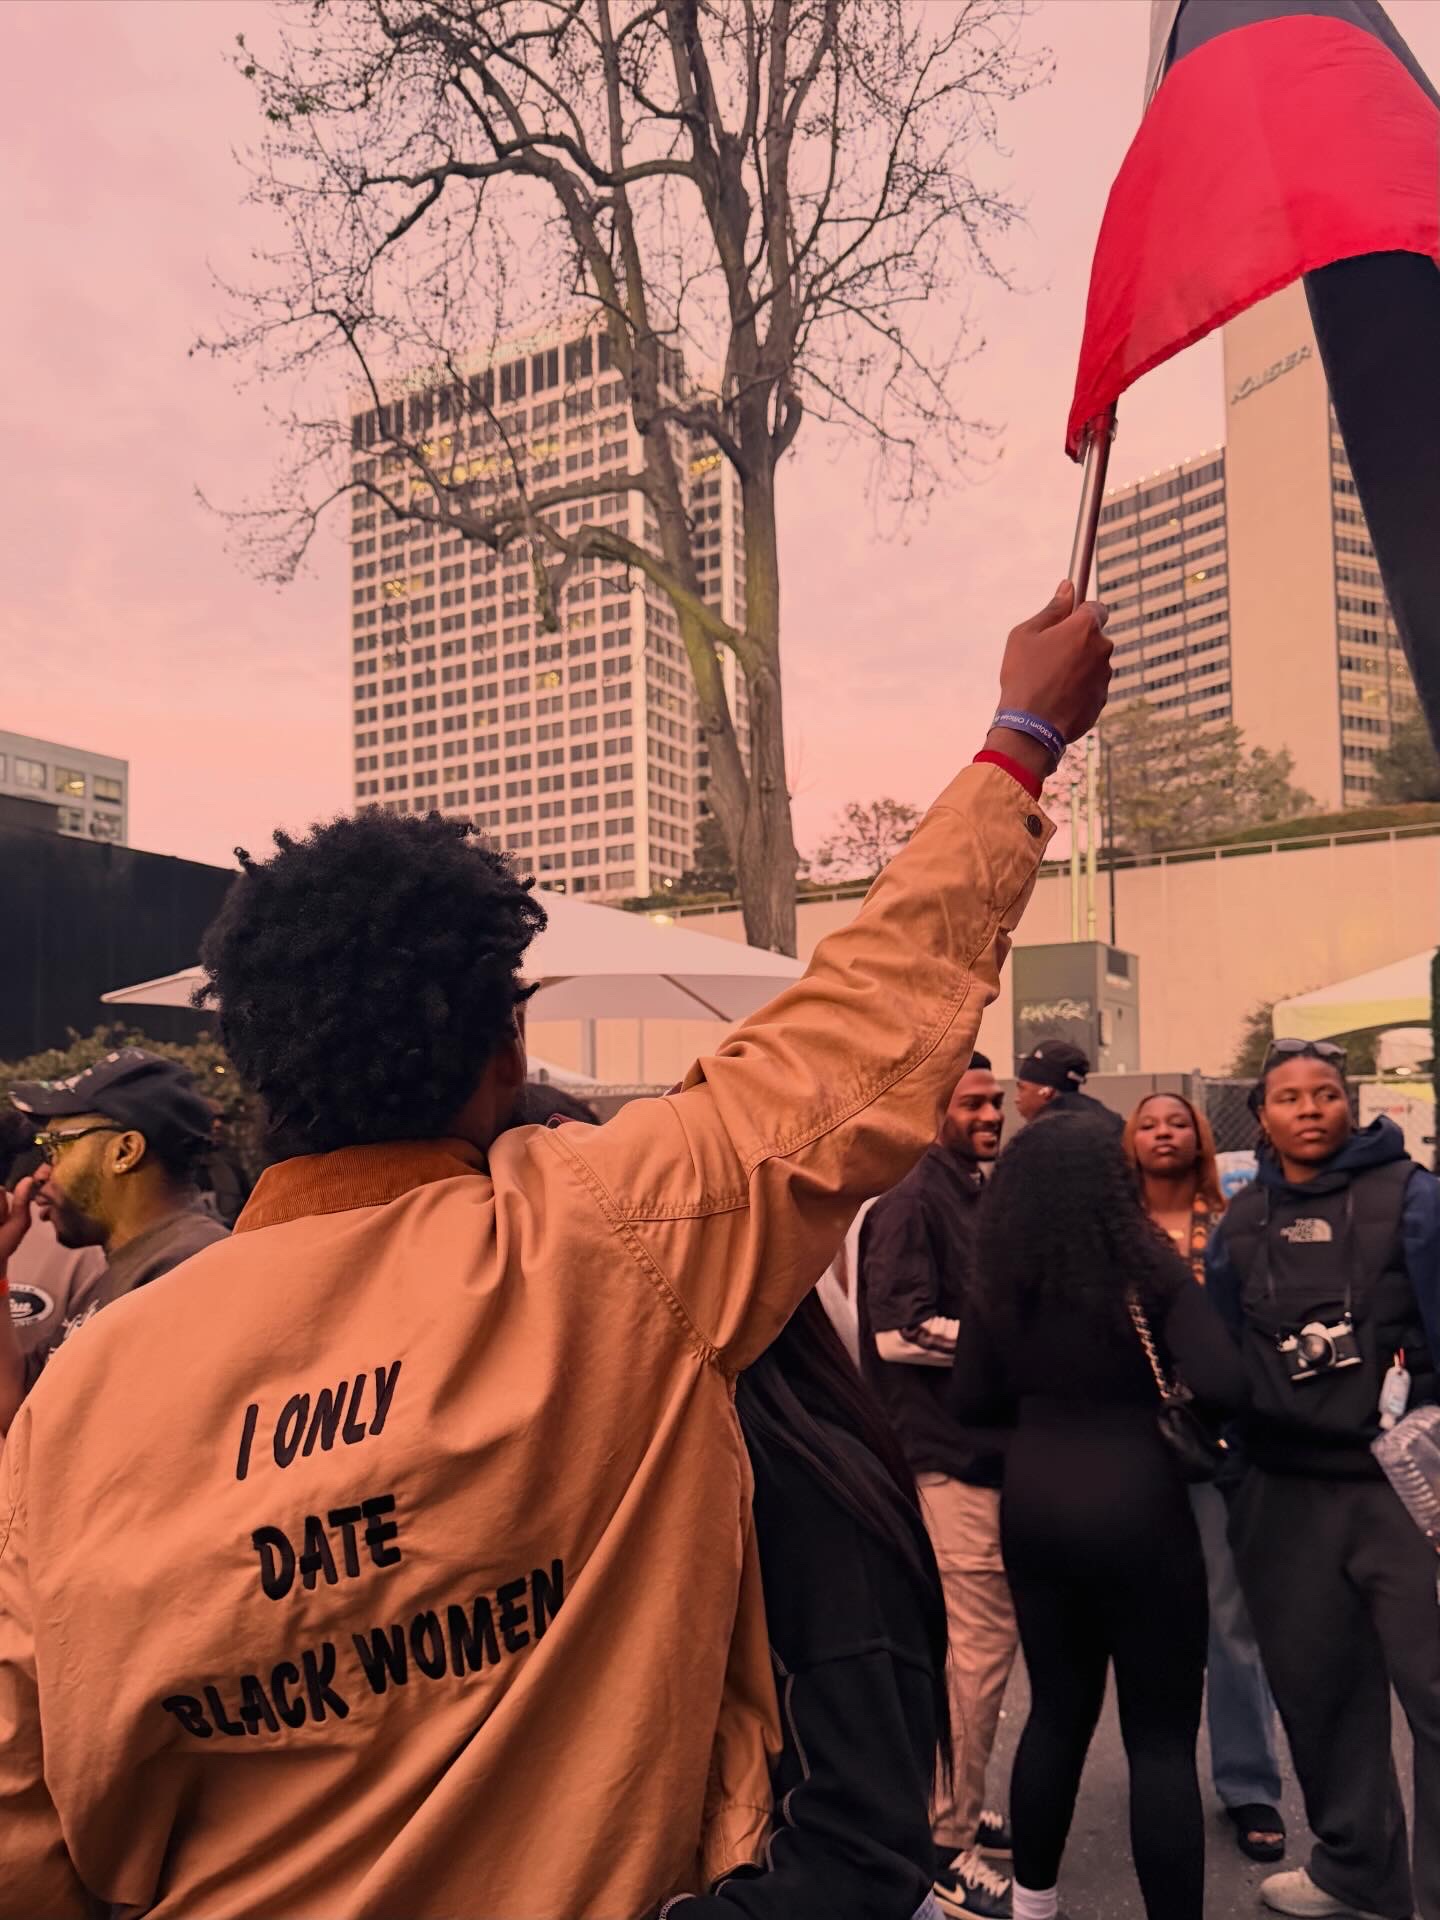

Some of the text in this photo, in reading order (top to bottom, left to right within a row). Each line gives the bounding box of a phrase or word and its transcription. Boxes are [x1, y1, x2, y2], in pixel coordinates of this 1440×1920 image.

[236, 1360, 402, 1480] I ONLY
[251, 1494, 401, 1601] DATE
[162, 1559, 565, 1738] BLACK WOMEN
